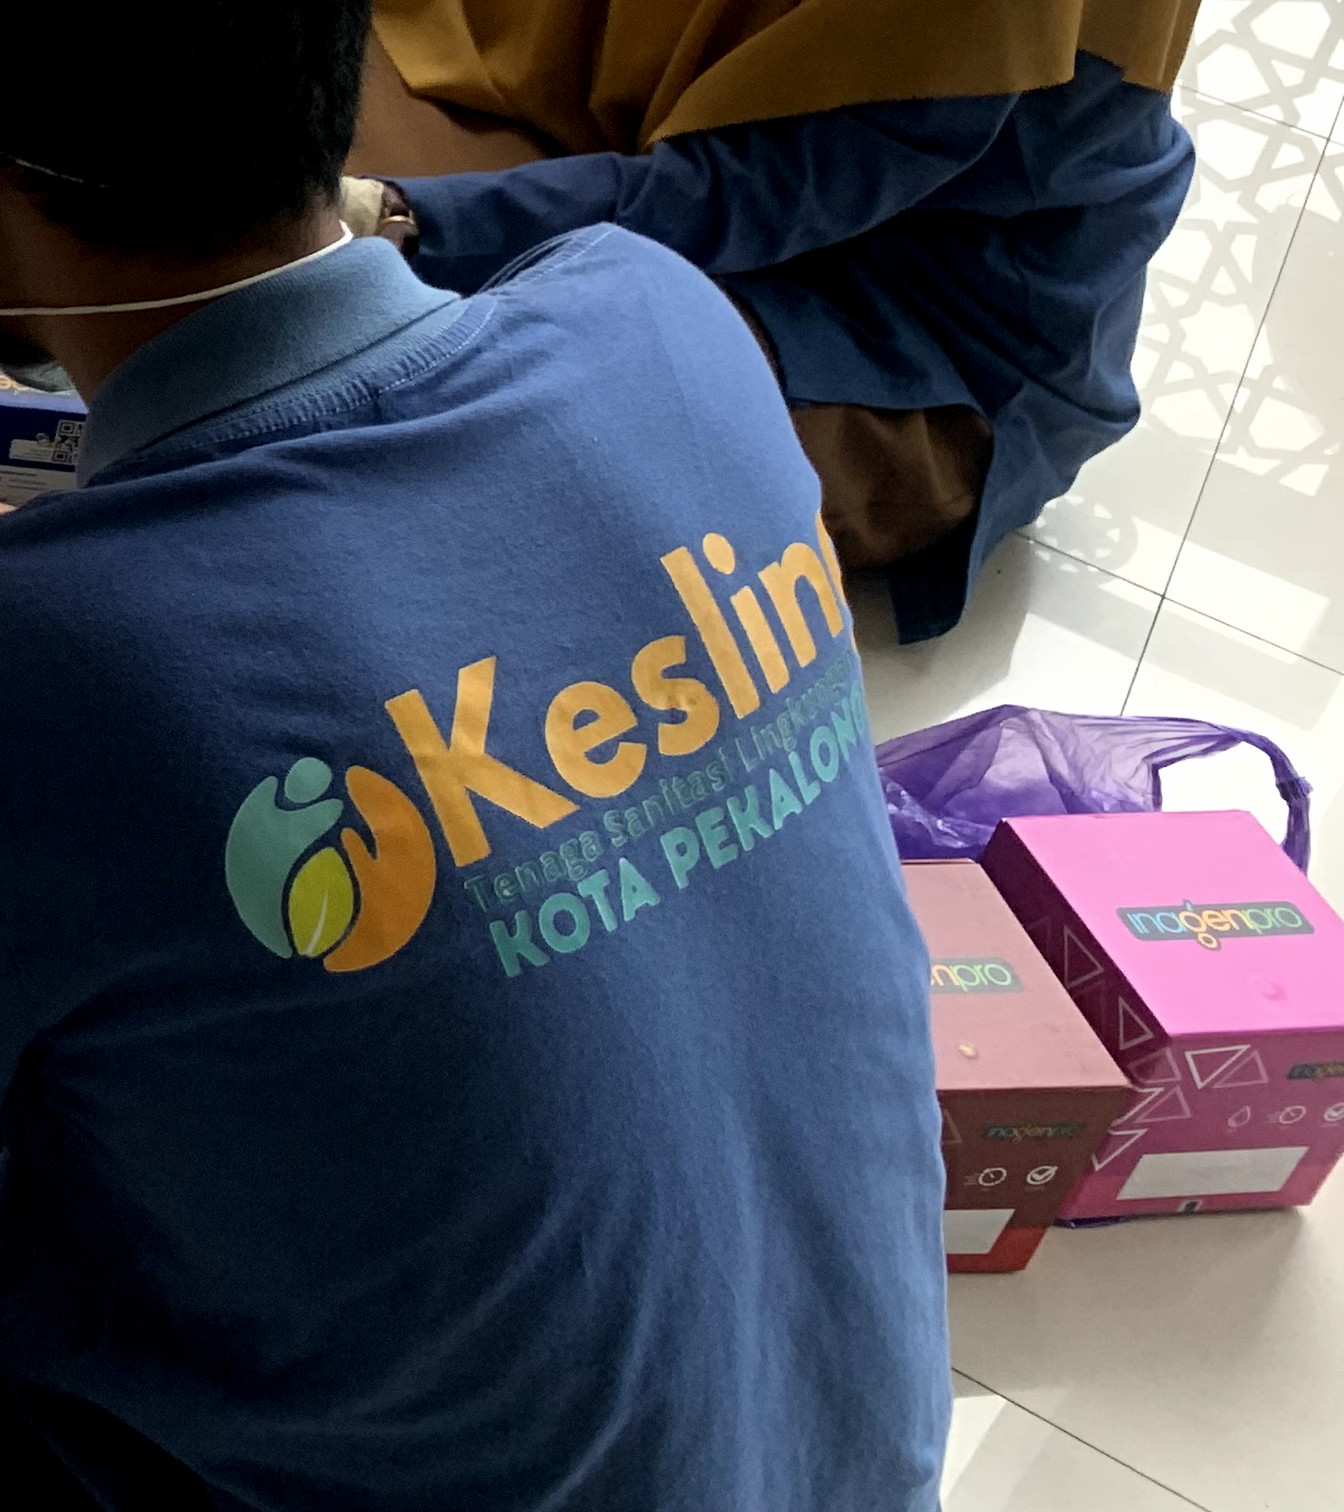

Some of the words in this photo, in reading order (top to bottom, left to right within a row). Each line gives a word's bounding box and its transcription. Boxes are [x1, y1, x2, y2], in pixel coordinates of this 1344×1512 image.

[385, 511, 855, 867] Keslin
[464, 830, 604, 912] Tenaga
[602, 748, 733, 847] Sanitasi
[489, 857, 661, 978] KOTA
